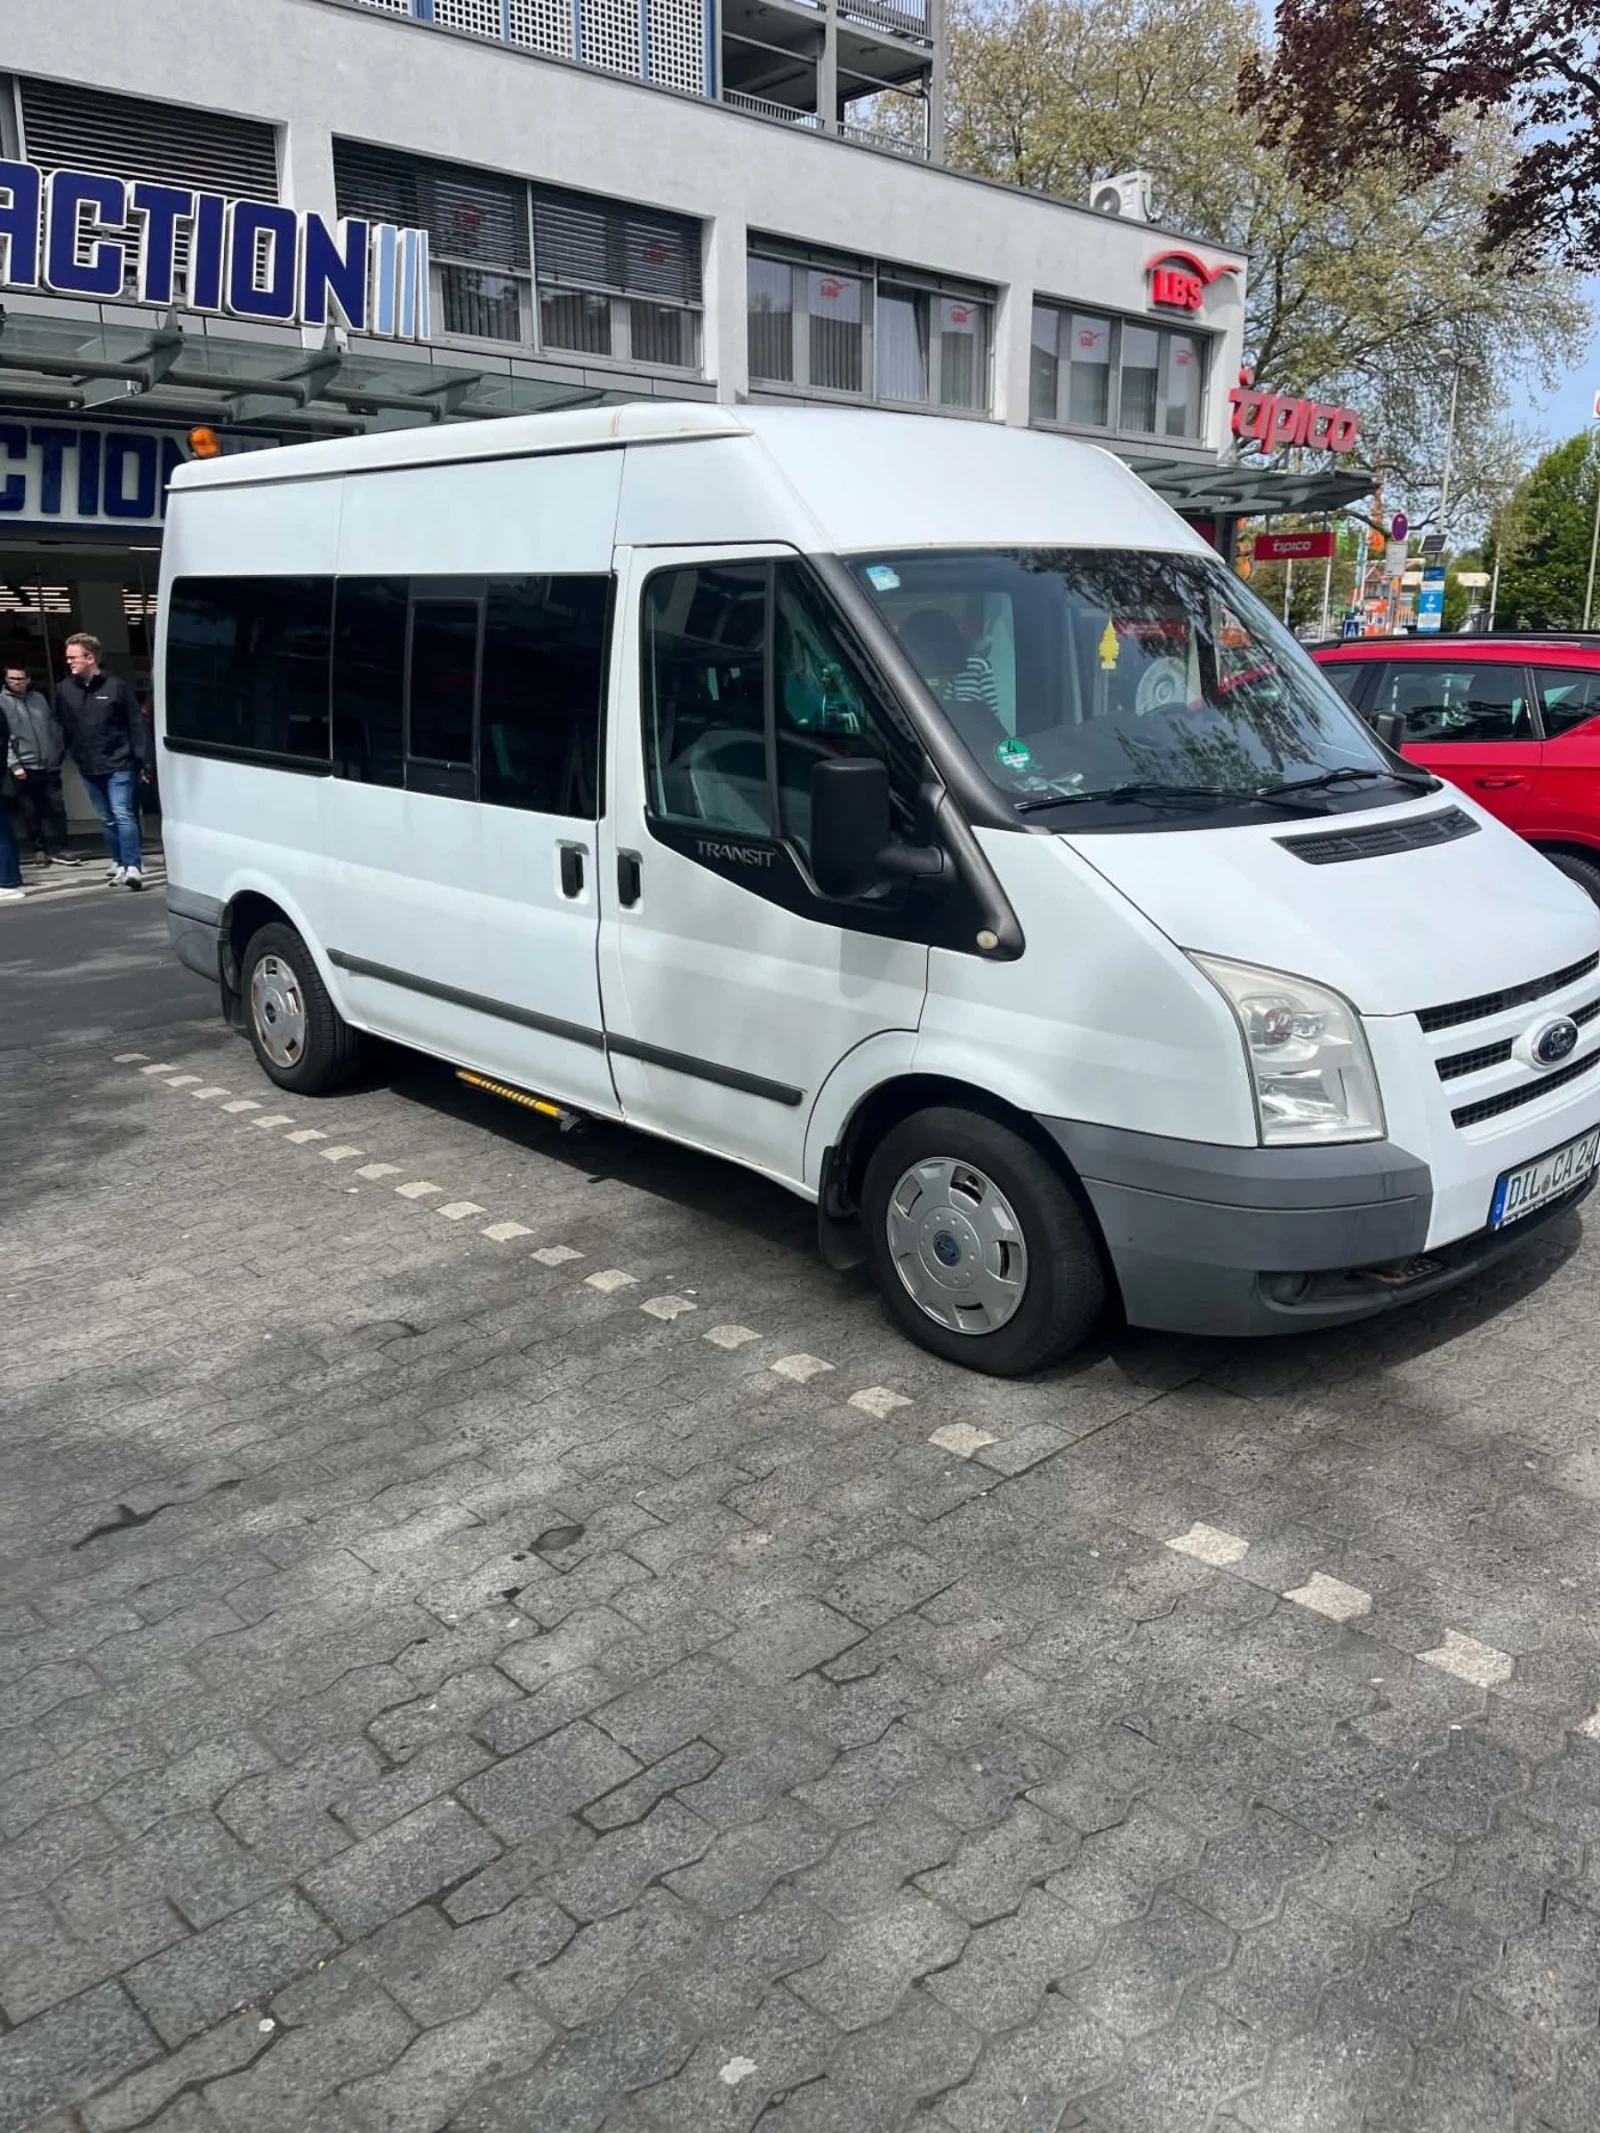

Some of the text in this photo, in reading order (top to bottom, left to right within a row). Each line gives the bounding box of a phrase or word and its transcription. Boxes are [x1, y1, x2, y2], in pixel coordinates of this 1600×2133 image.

[1153, 268, 1204, 311] LBS
[1228, 368, 1358, 454] tipico
[1273, 540, 1312, 554] tipico
[1007, 740, 1018, 754] 4
[696, 840, 775, 868] TRANSIT
[1507, 1167, 1540, 1211] DIL
[1552, 1148, 1574, 1187] CA
